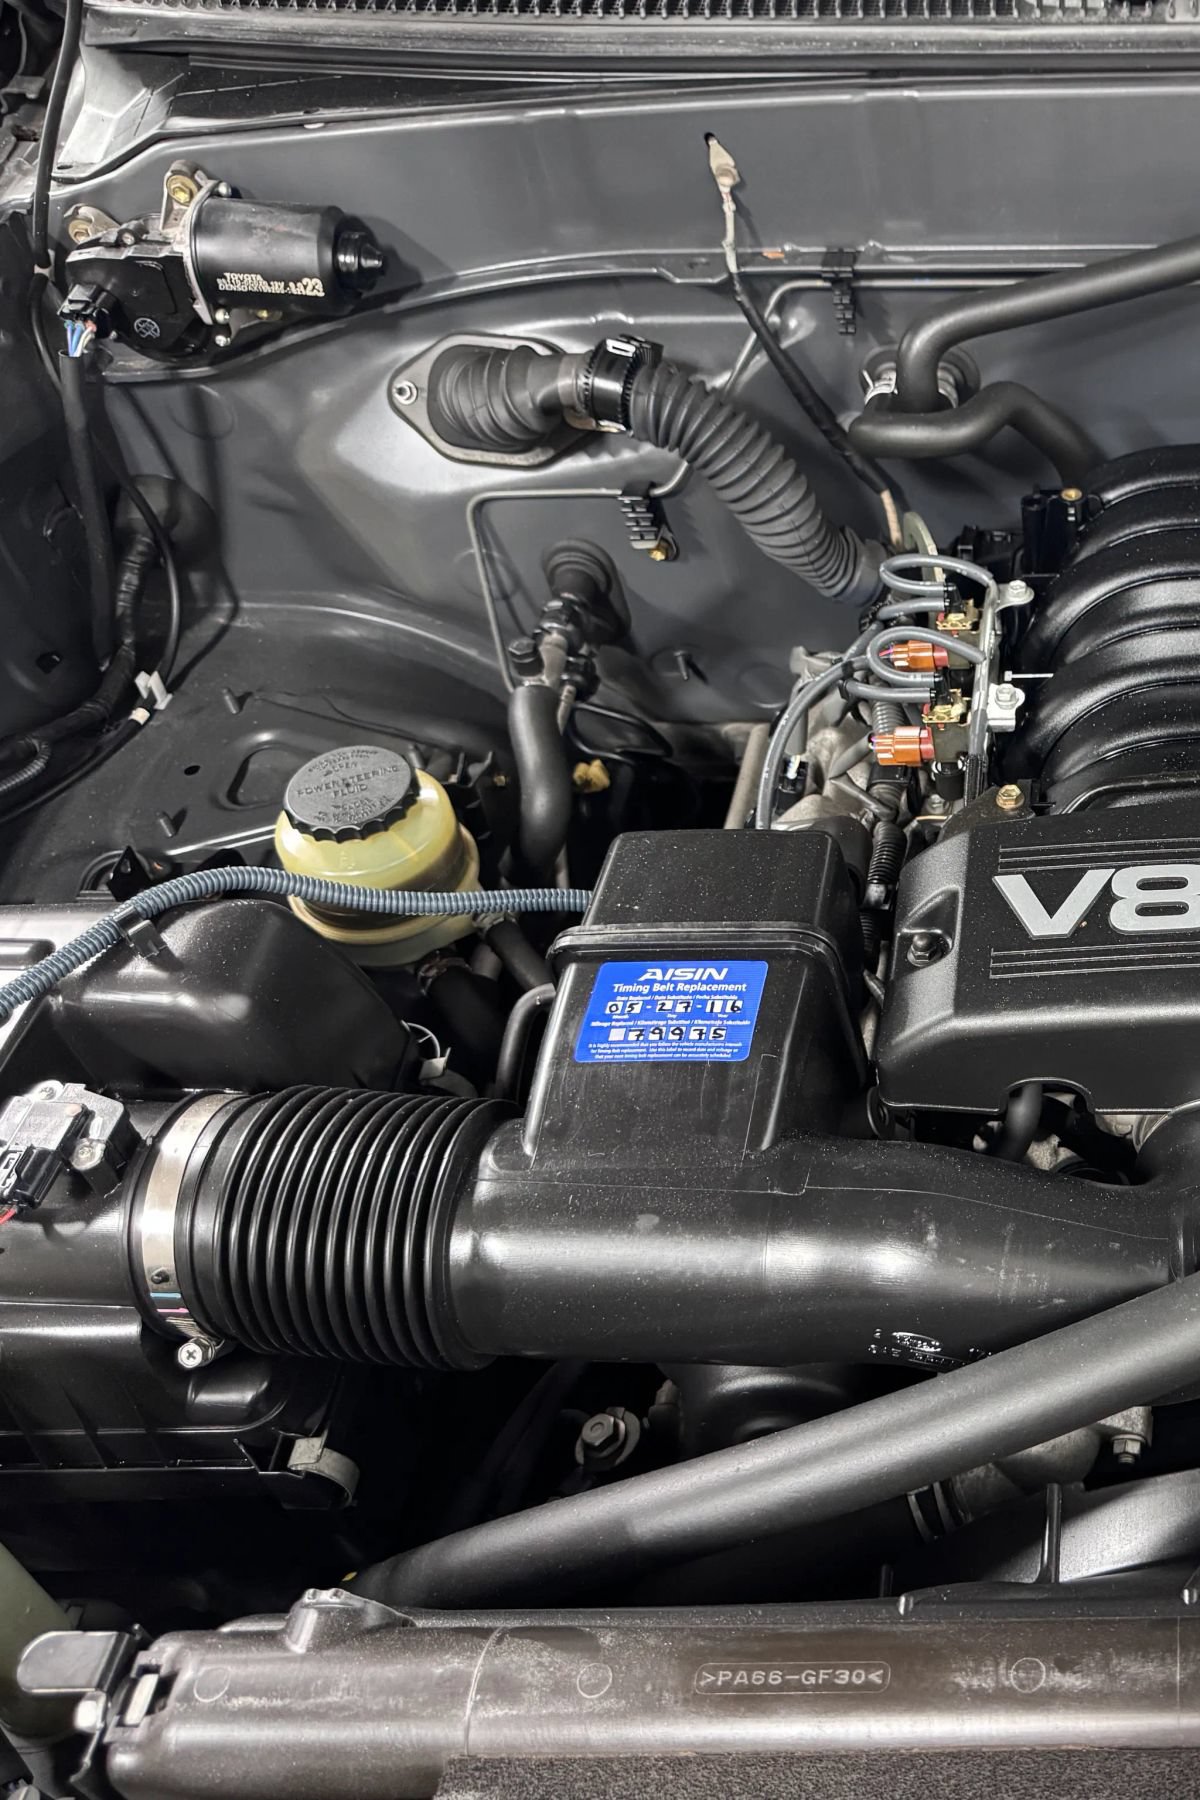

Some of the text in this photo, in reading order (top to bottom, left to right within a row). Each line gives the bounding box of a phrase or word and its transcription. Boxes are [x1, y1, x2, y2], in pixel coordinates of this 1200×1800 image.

[223, 272, 263, 281] TOYOTA
[333, 784, 368, 798] FLUID
[637, 968, 728, 981] AISIN
[613, 983, 747, 994] Timing Belt Replacement
[631, 1027, 725, 1040] 79975
